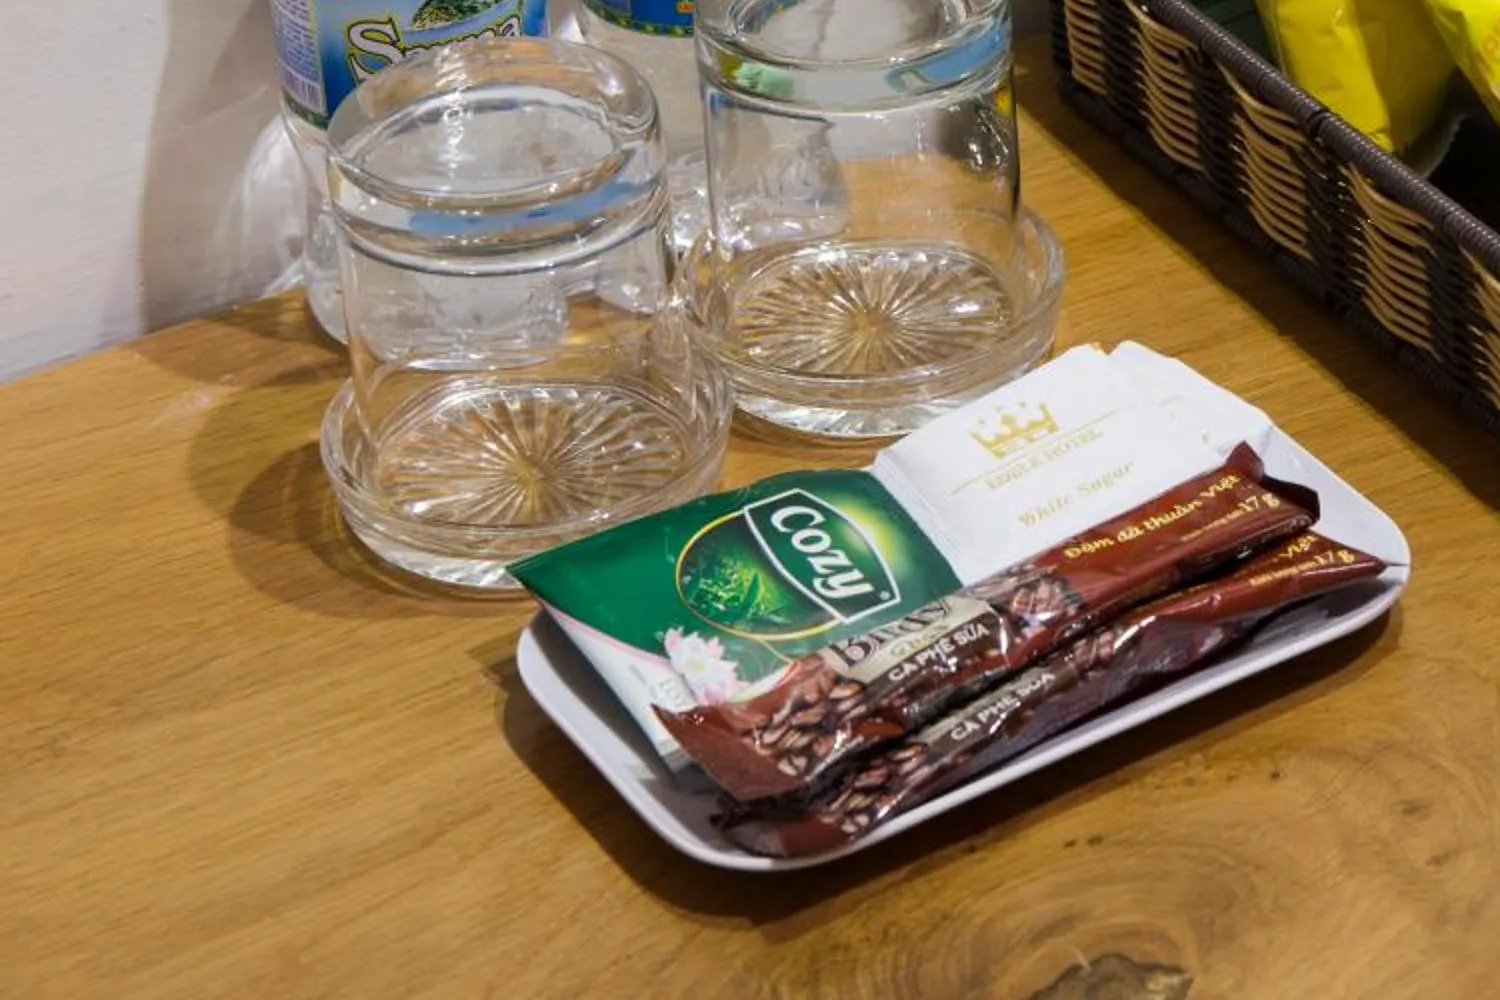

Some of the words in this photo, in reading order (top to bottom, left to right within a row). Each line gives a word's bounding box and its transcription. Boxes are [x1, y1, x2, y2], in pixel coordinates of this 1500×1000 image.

[1017, 492, 1074, 528] White
[1077, 461, 1134, 496] Sugar
[769, 504, 876, 600] Cozy
